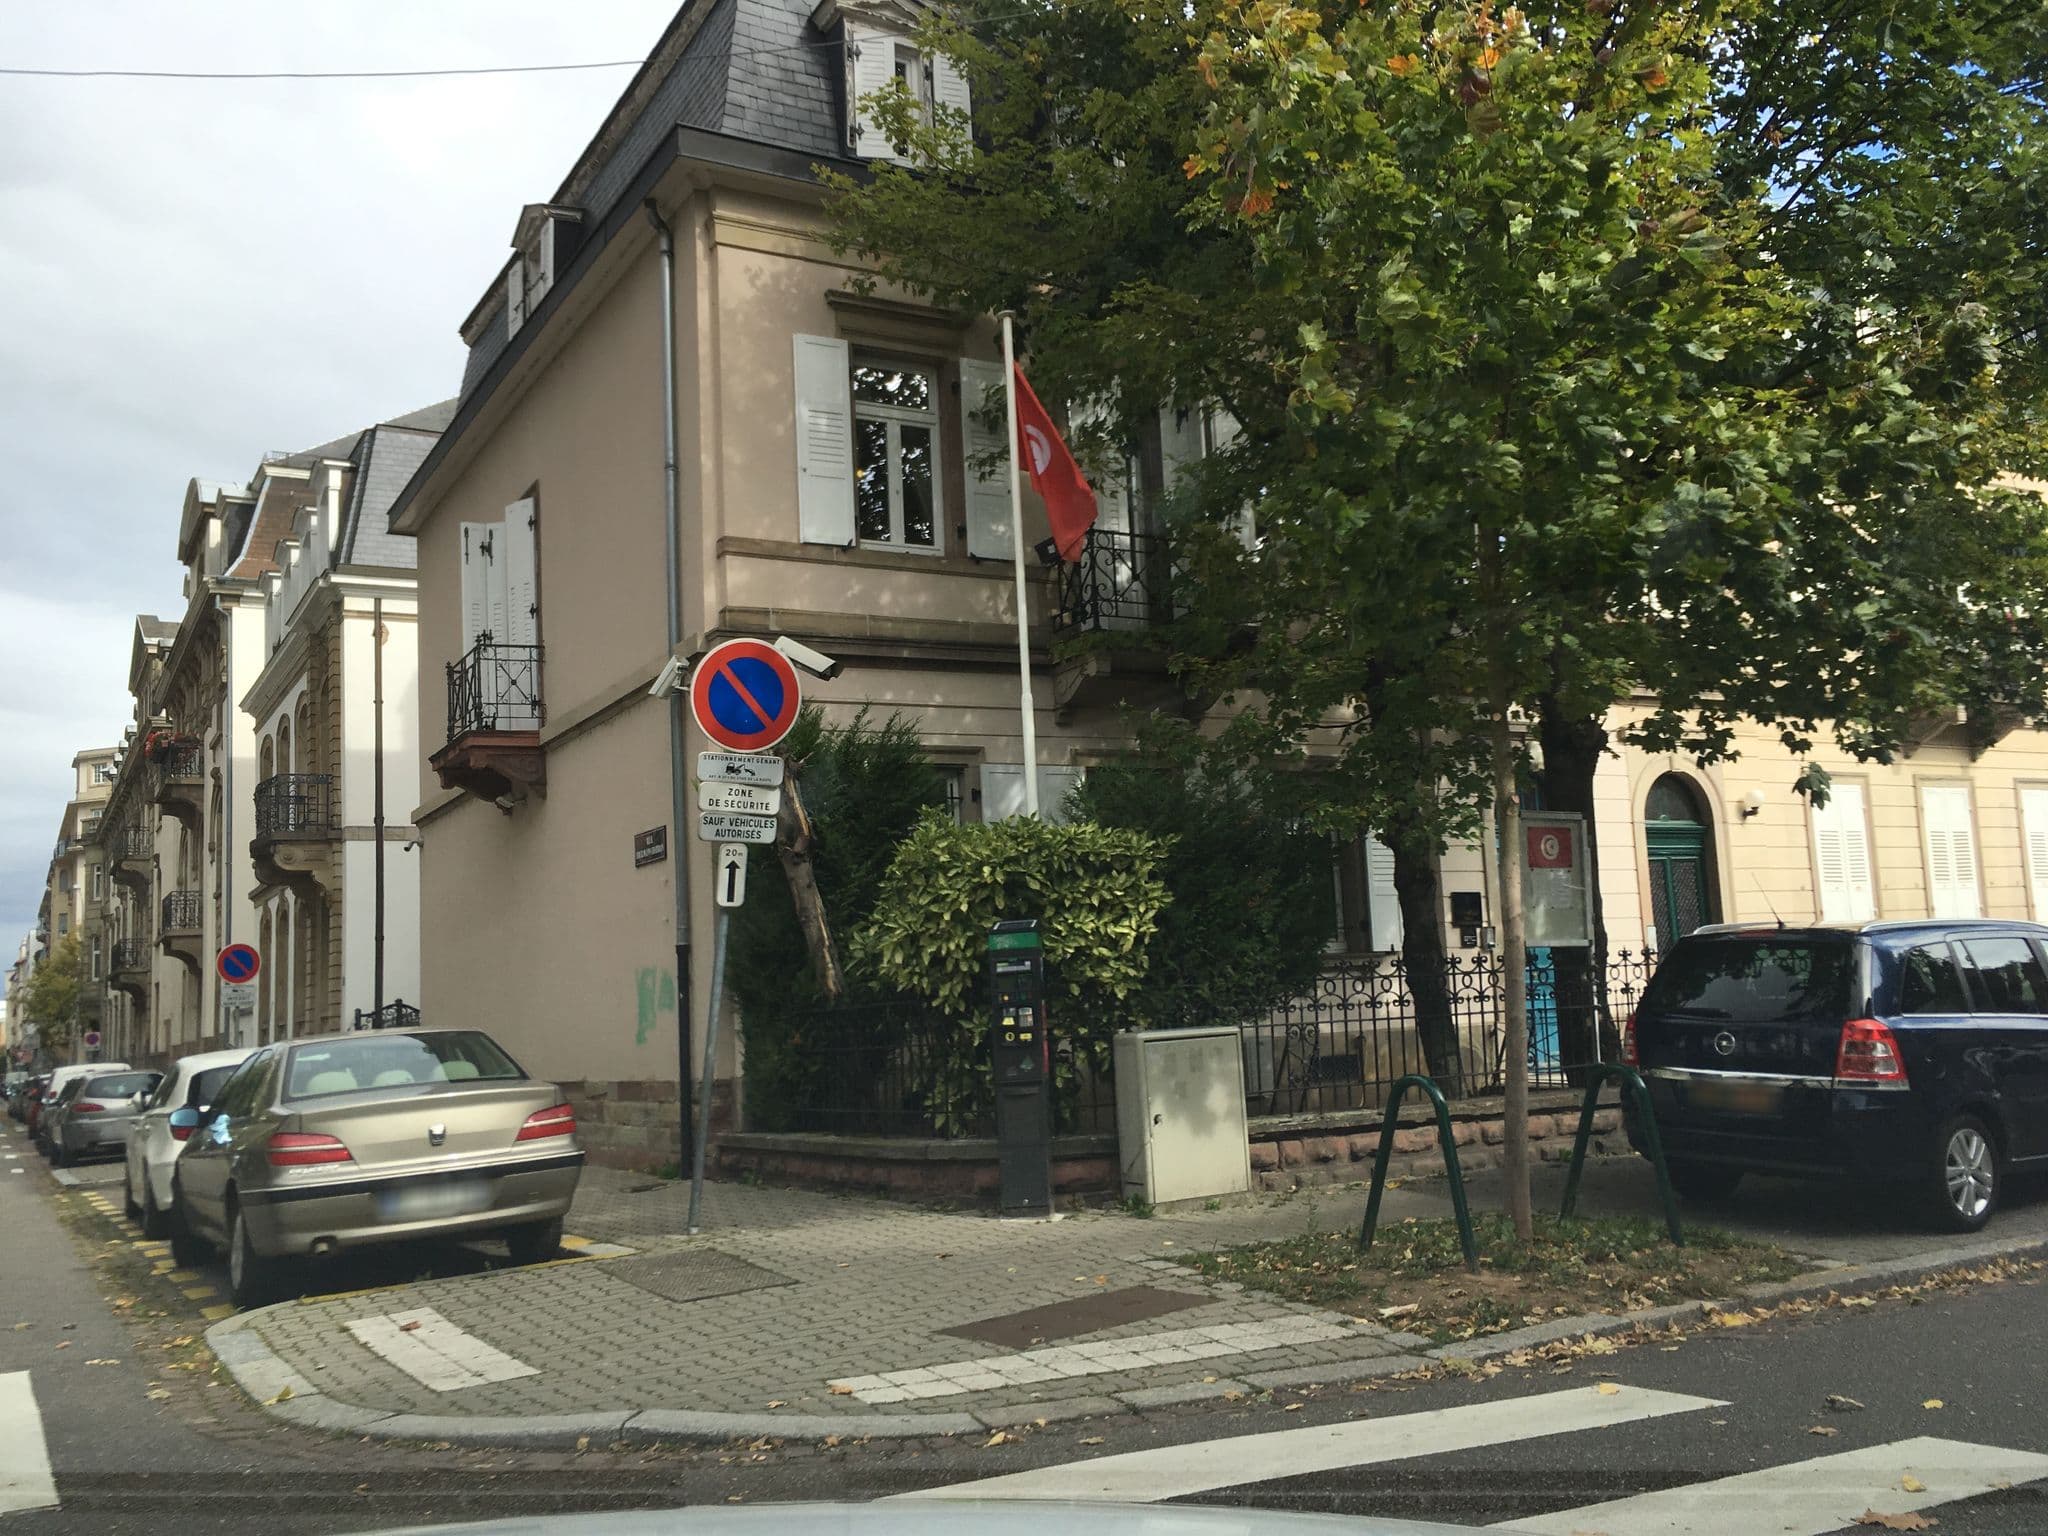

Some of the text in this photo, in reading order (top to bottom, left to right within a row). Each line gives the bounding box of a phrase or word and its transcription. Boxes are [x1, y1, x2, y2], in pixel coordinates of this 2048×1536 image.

[727, 788, 753, 798] ZONE
[708, 798, 721, 807] DE
[703, 816, 775, 829] SAUF VÉHICULES
[715, 828, 762, 839] AUTORISÉS
